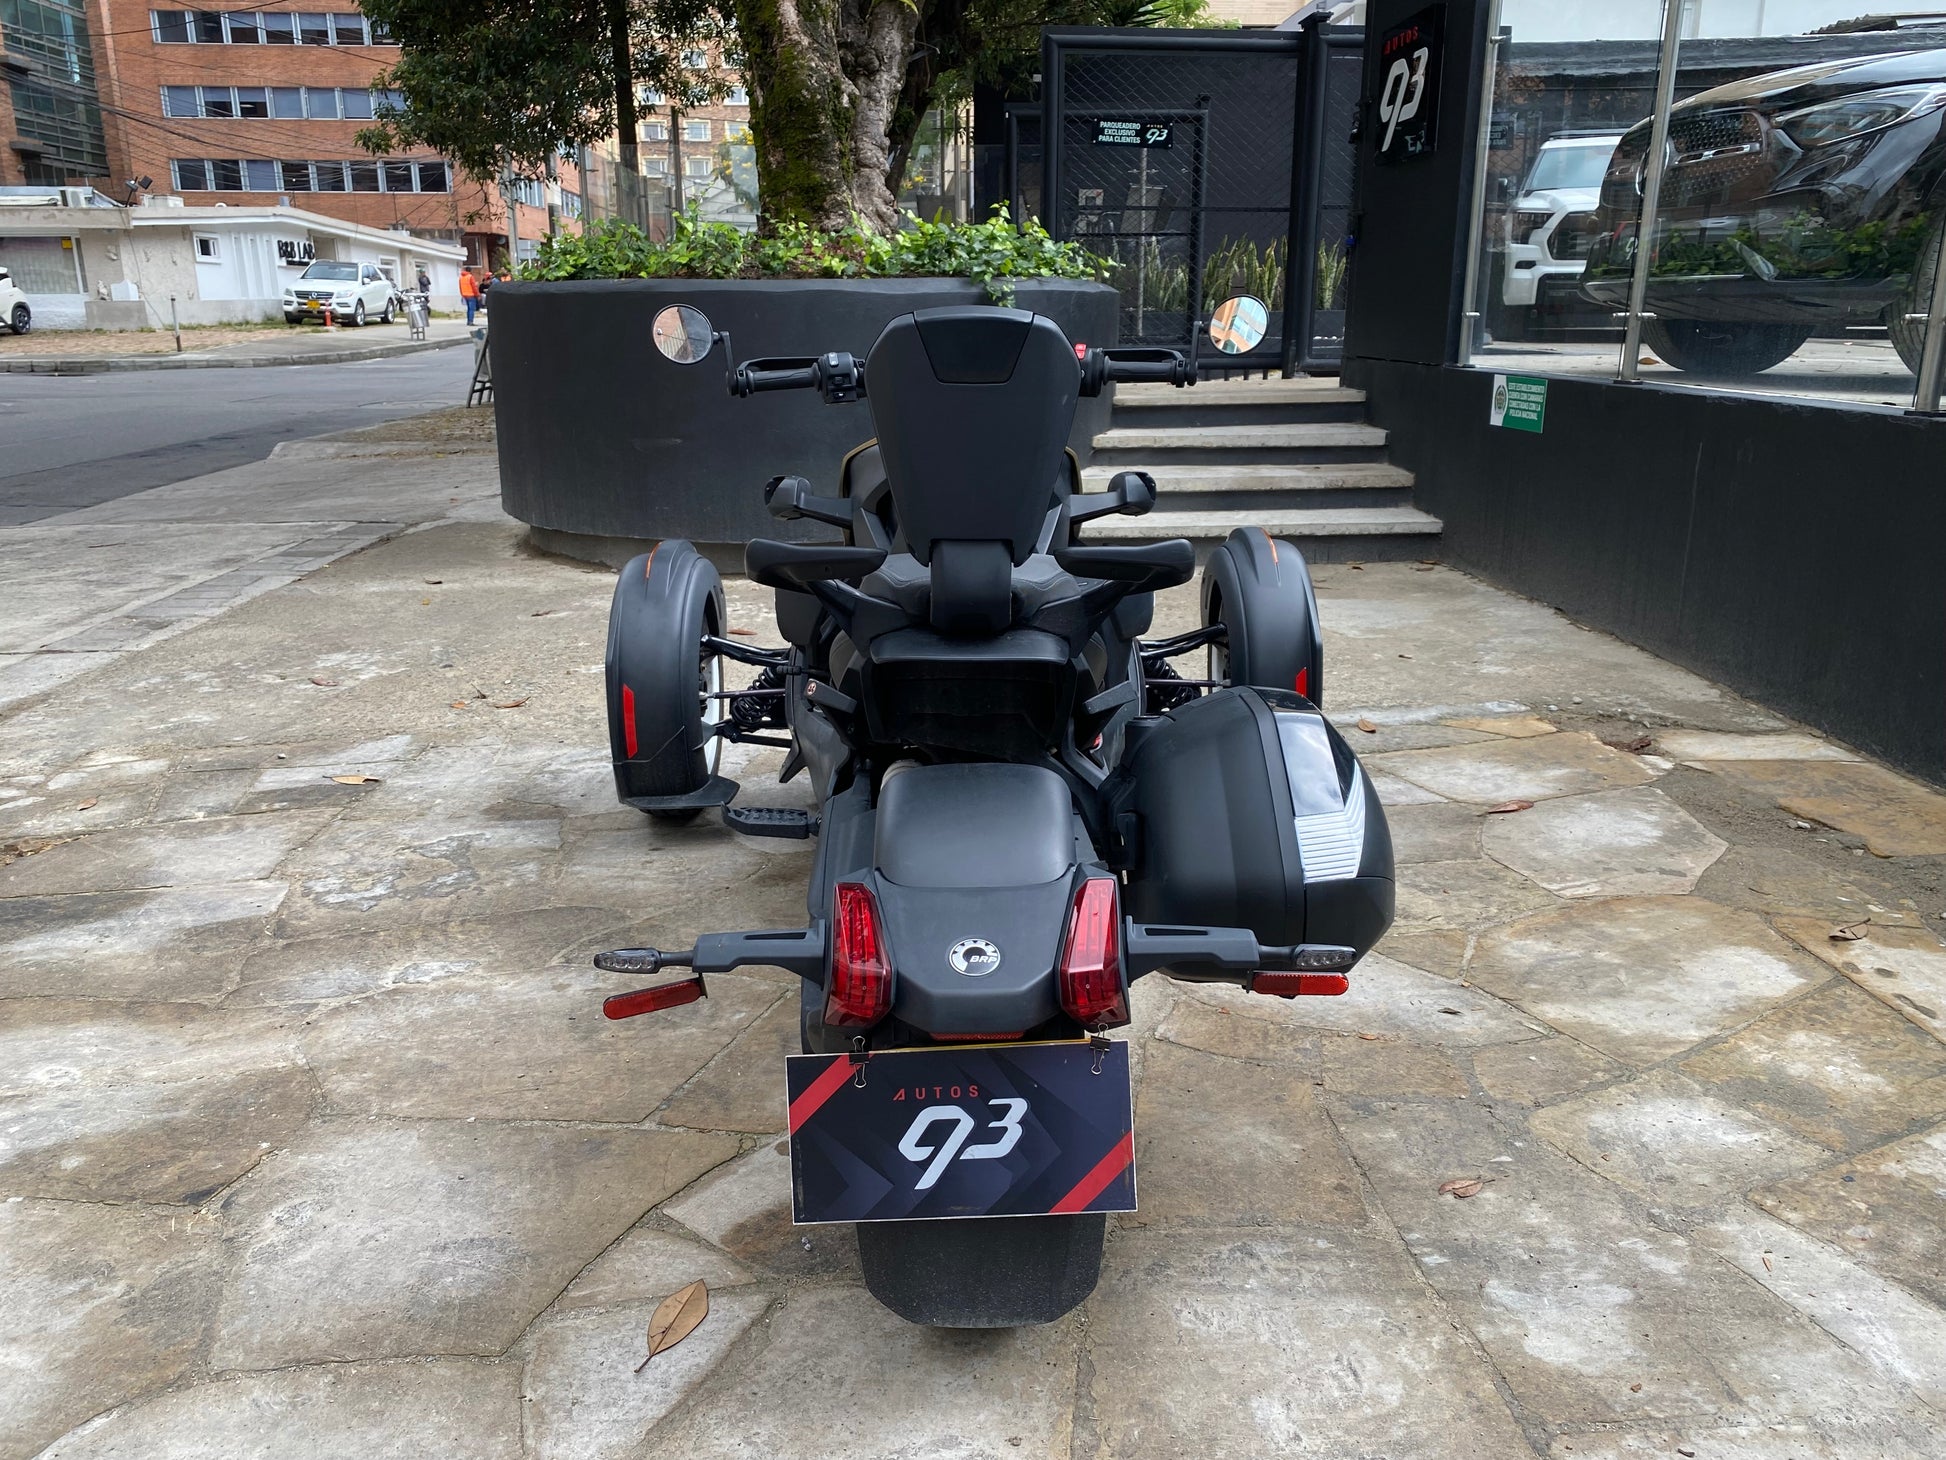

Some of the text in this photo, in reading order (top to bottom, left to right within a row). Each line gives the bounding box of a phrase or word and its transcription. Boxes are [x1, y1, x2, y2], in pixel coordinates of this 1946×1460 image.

[1385, 26, 1418, 55] AUTOS
[1380, 47, 1428, 152] 93
[1100, 121, 1141, 130] PARQUEADERO
[1105, 129, 1136, 137] EXCLUSIVO
[1099, 135, 1141, 144] PARA CLIENTES
[1146, 128, 1168, 144] 93
[297, 241, 315, 260] LAB
[970, 955, 998, 963] BRP
[893, 1085, 979, 1101] AUTOS
[898, 1097, 1028, 1190] 93
